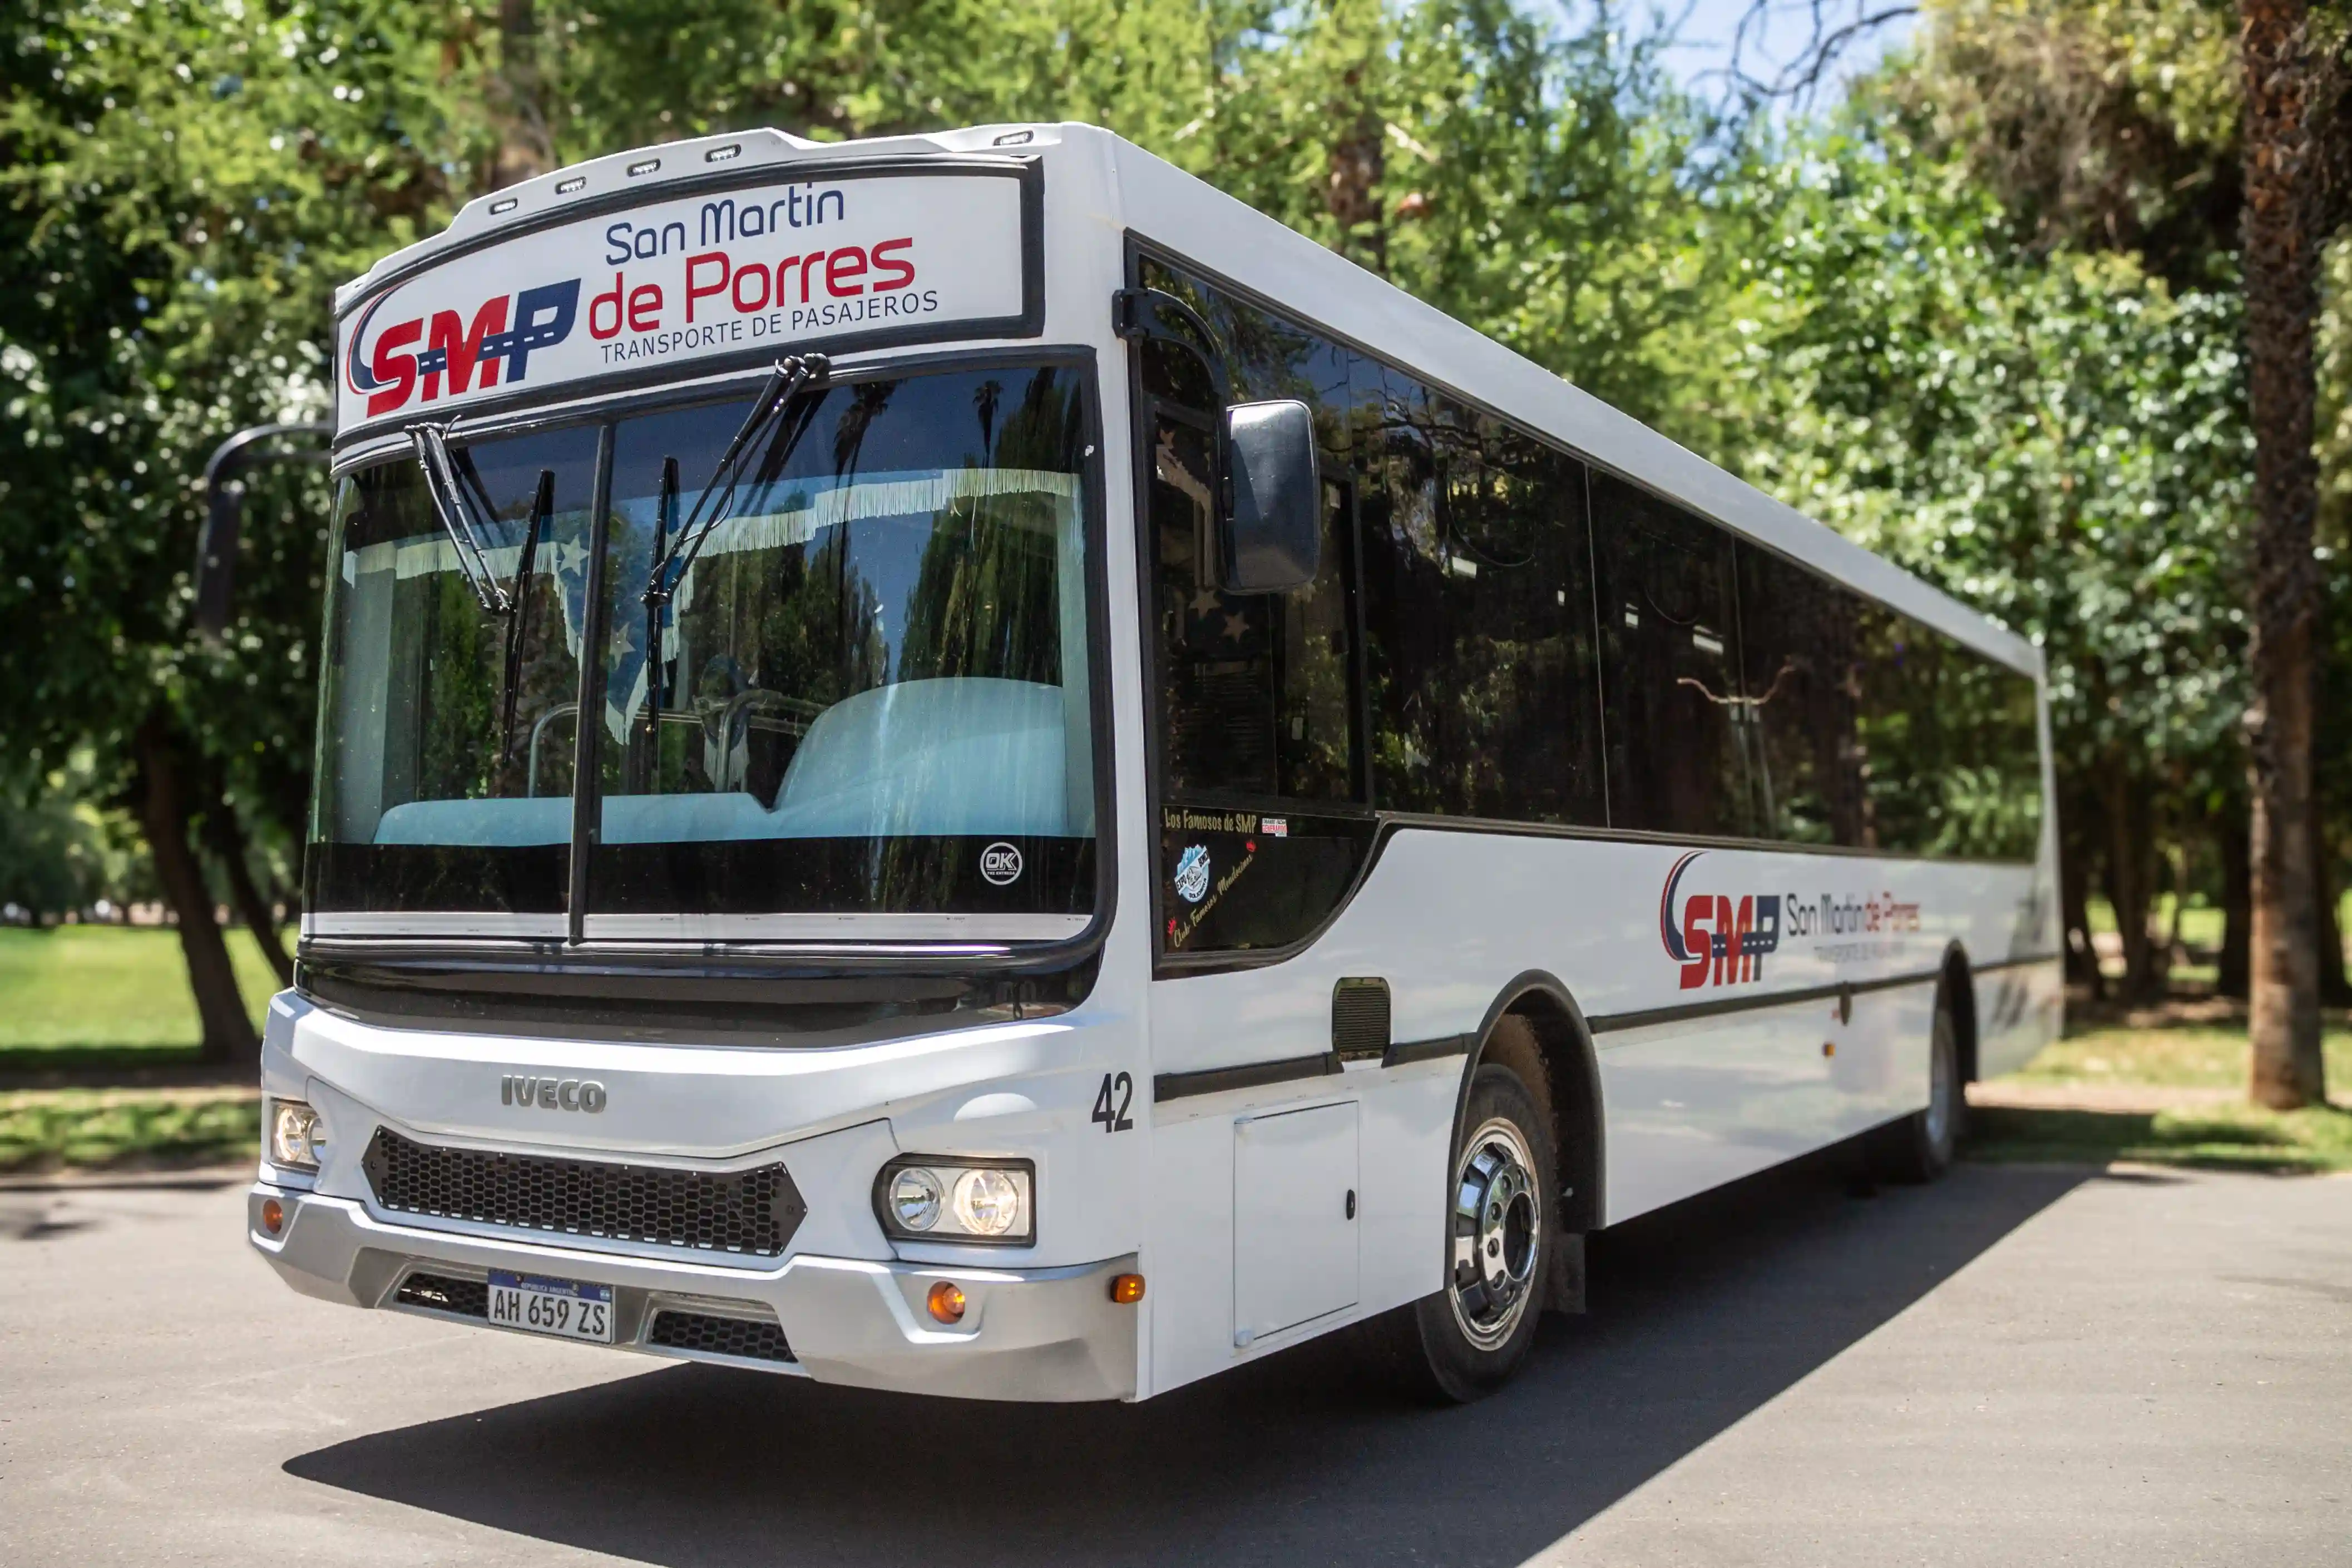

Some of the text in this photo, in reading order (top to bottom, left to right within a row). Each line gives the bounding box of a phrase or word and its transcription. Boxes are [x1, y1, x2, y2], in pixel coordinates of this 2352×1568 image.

[605, 183, 844, 266] San Martin
[589, 237, 915, 340] de Porres
[367, 278, 581, 418] SMP
[601, 290, 938, 364] TRANSPORTE DE PASAJEROS
[1164, 808, 1257, 834] Los Famosos de SMP
[985, 853, 1017, 870] OK
[1174, 921, 1191, 948] Club
[1679, 894, 1781, 990] SMP
[1786, 893, 1817, 937] San
[501, 1075, 606, 1113] IVECO
[1091, 1071, 1133, 1133] 42
[495, 1289, 605, 1335] AH 659 ZS
